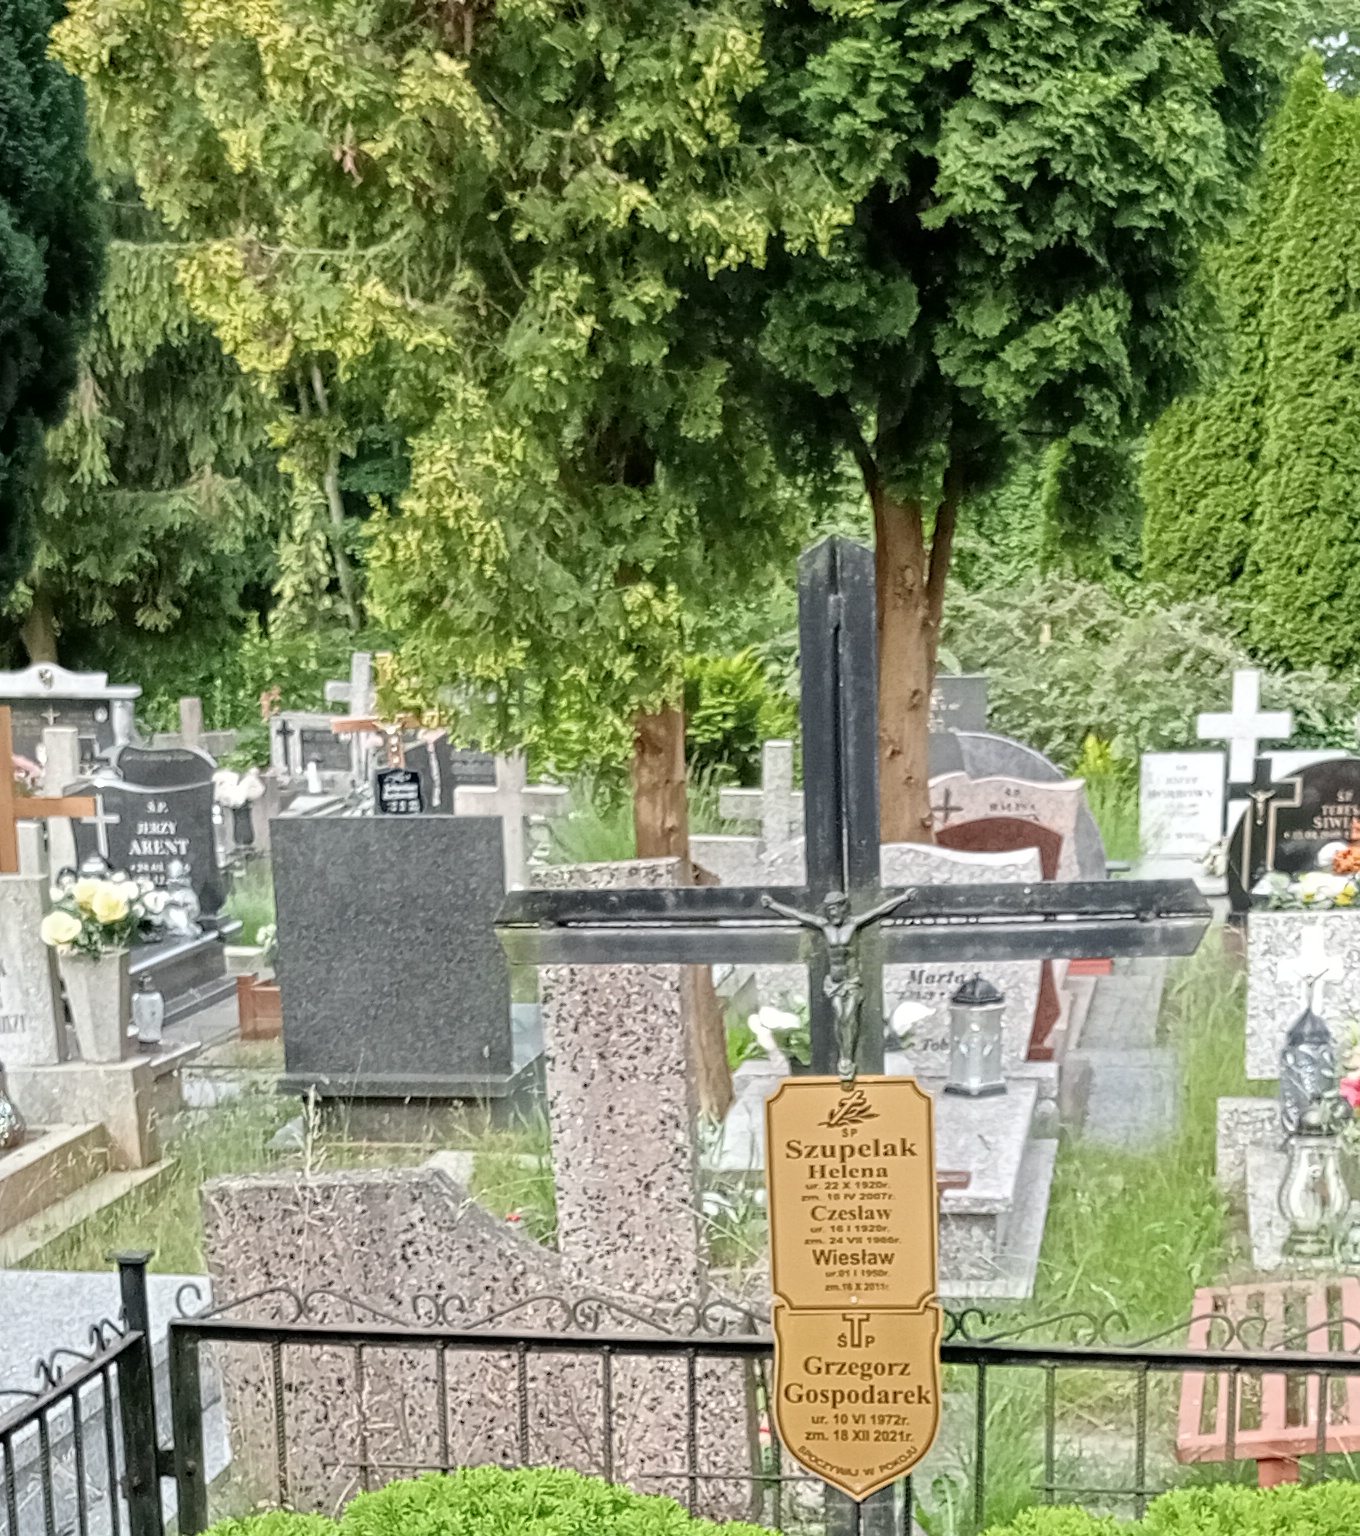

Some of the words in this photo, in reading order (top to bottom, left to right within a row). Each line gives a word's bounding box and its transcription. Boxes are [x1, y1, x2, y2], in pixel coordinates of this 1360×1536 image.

[137, 821, 177, 835] JERZY
[129, 838, 189, 855] ARENT
[785, 1138, 918, 1163] Szupelak
[807, 1165, 889, 1179] Helena
[824, 1181, 839, 1190] 22
[842, 1181, 851, 1190] X
[812, 1249, 895, 1266] Wiesław
[865, 1335, 876, 1348] P
[803, 1355, 911, 1381] Grzegorz
[783, 1382, 932, 1409] Gospodarek
[811, 1415, 828, 1425] ur.
[834, 1414, 848, 1425] 10
[852, 1414, 866, 1424] VI
[870, 1415, 910, 1426] 1972r.
[804, 1431, 829, 1441] zm.
[834, 1430, 849, 1441] 18
[852, 1430, 870, 1441] XII
[873, 1431, 914, 1442] 2021r.
[797, 1444, 860, 1477] SPOCZYWAJ
[878, 1445, 919, 1474] POKOJU
